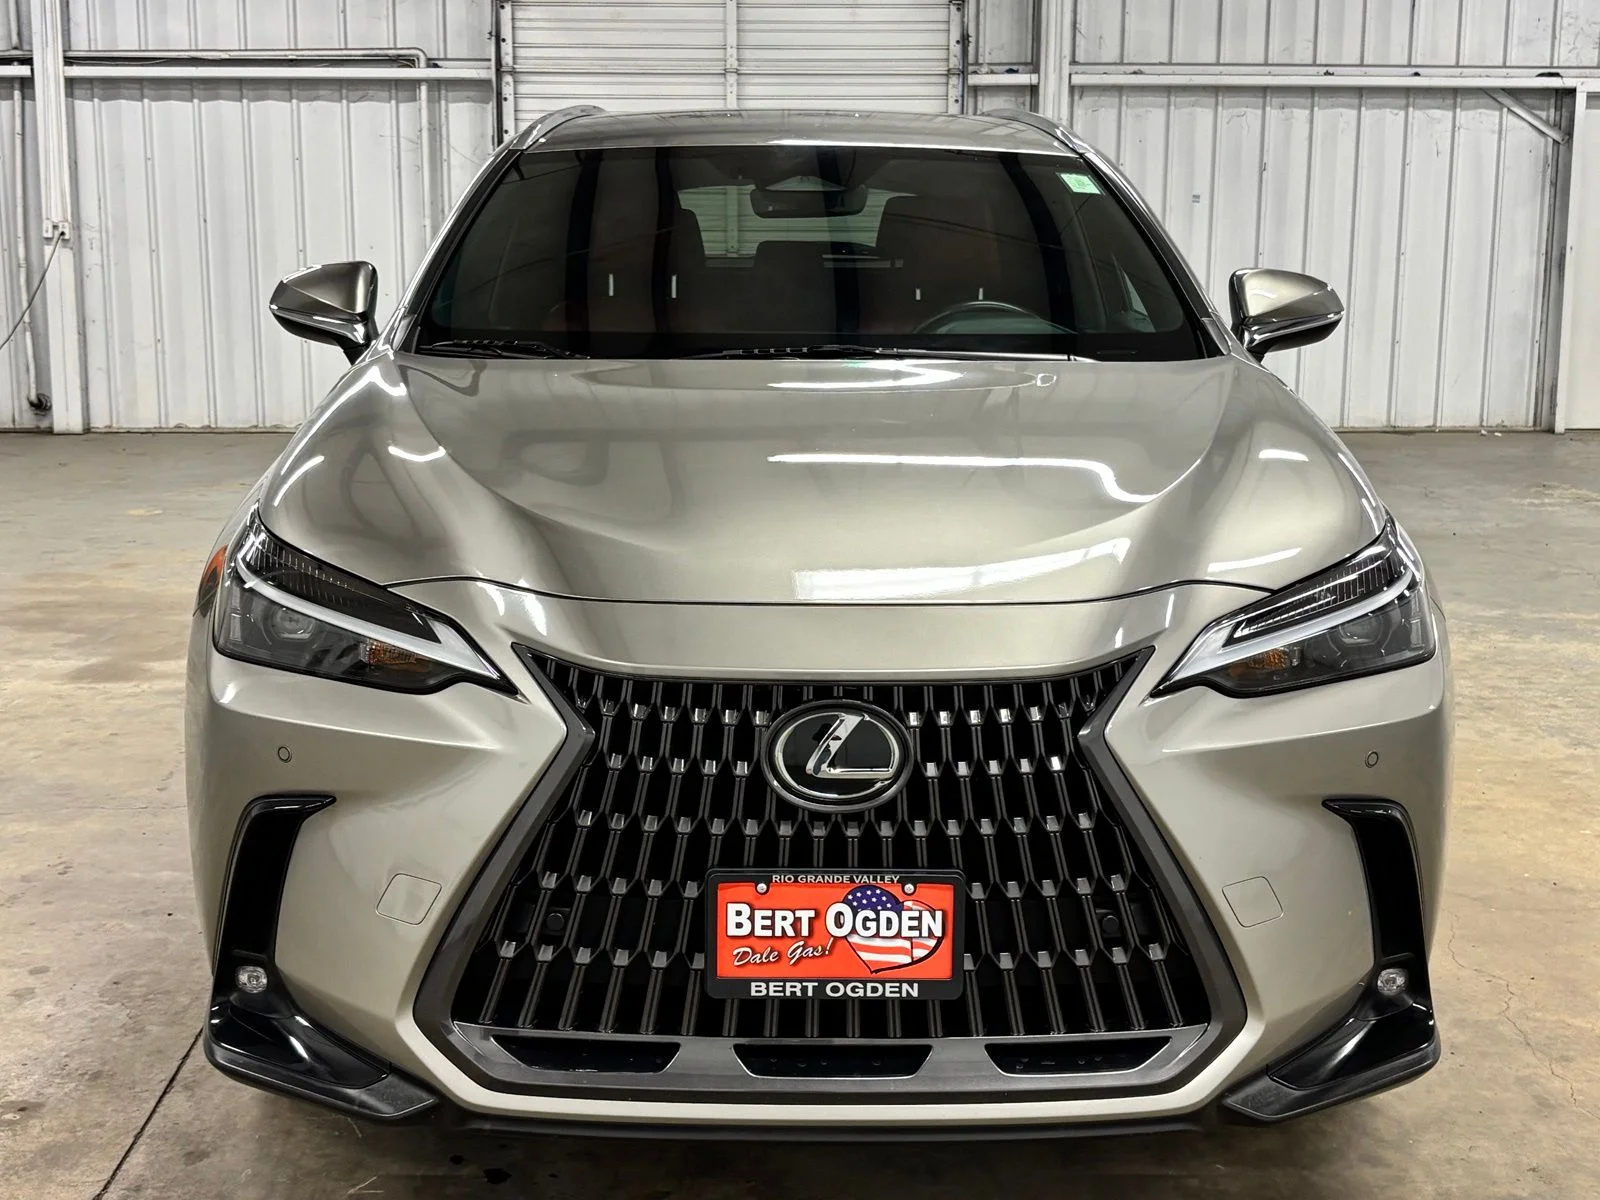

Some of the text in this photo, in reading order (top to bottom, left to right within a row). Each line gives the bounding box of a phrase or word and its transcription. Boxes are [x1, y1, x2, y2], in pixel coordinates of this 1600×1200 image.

[772, 874, 900, 885] RIO GRANDE VALLEY
[726, 902, 943, 938] BERT OGDEN
[732, 938, 834, 966] Dale Gas!
[750, 982, 919, 997] BERT OGDEN
